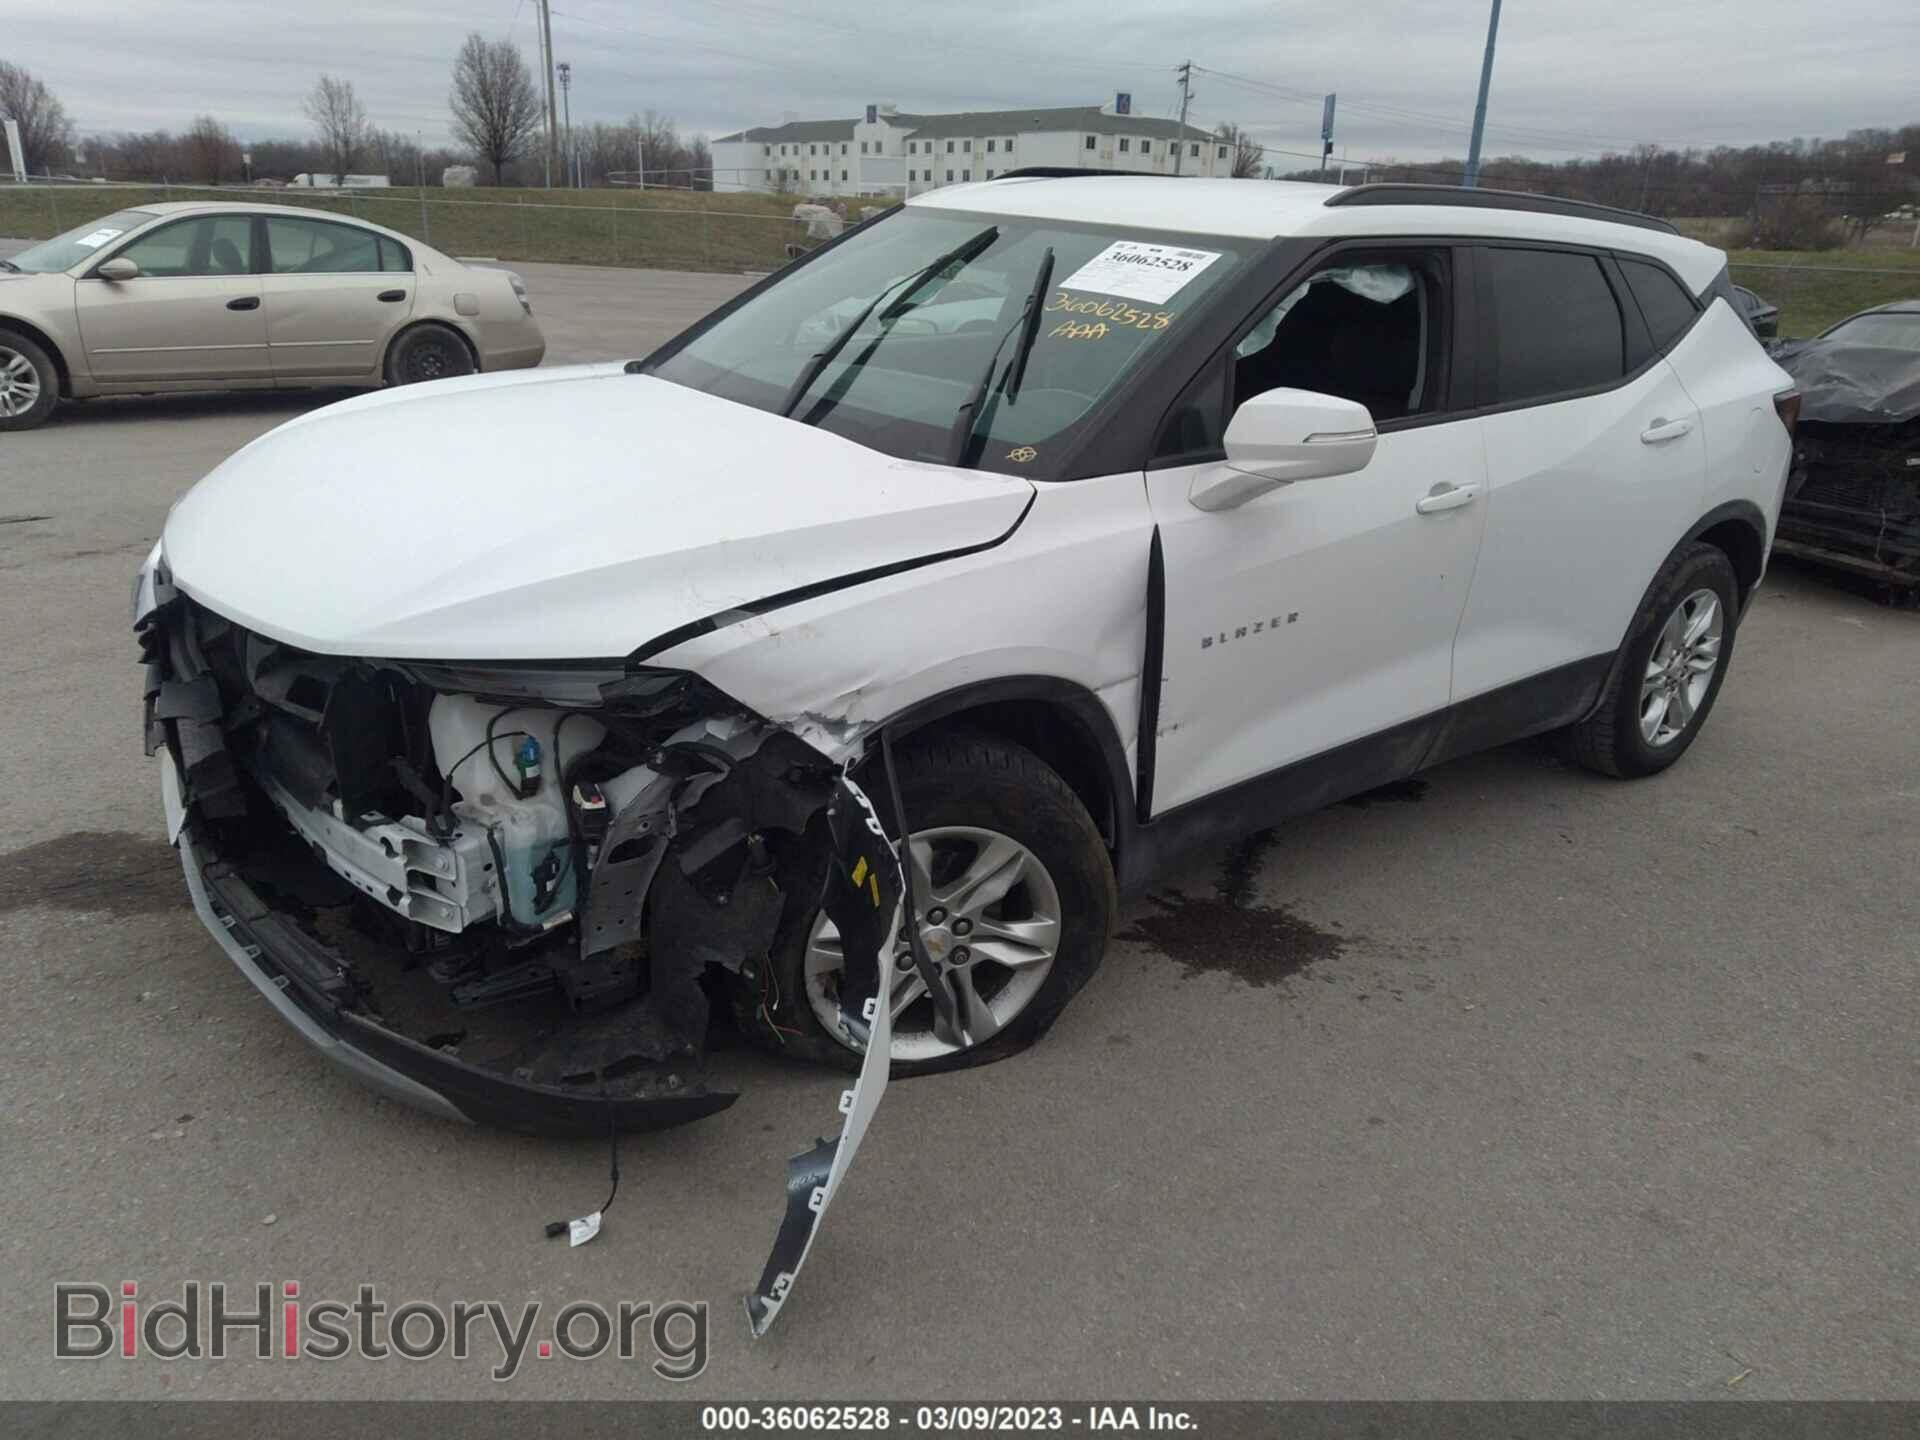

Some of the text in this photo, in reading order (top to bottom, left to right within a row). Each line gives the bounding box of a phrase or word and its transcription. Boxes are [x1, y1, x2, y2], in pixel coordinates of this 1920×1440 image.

[1105, 251, 1194, 272] 36062528
[1044, 292, 1174, 329] 36062528
[1201, 611, 1299, 649] BLAZER
